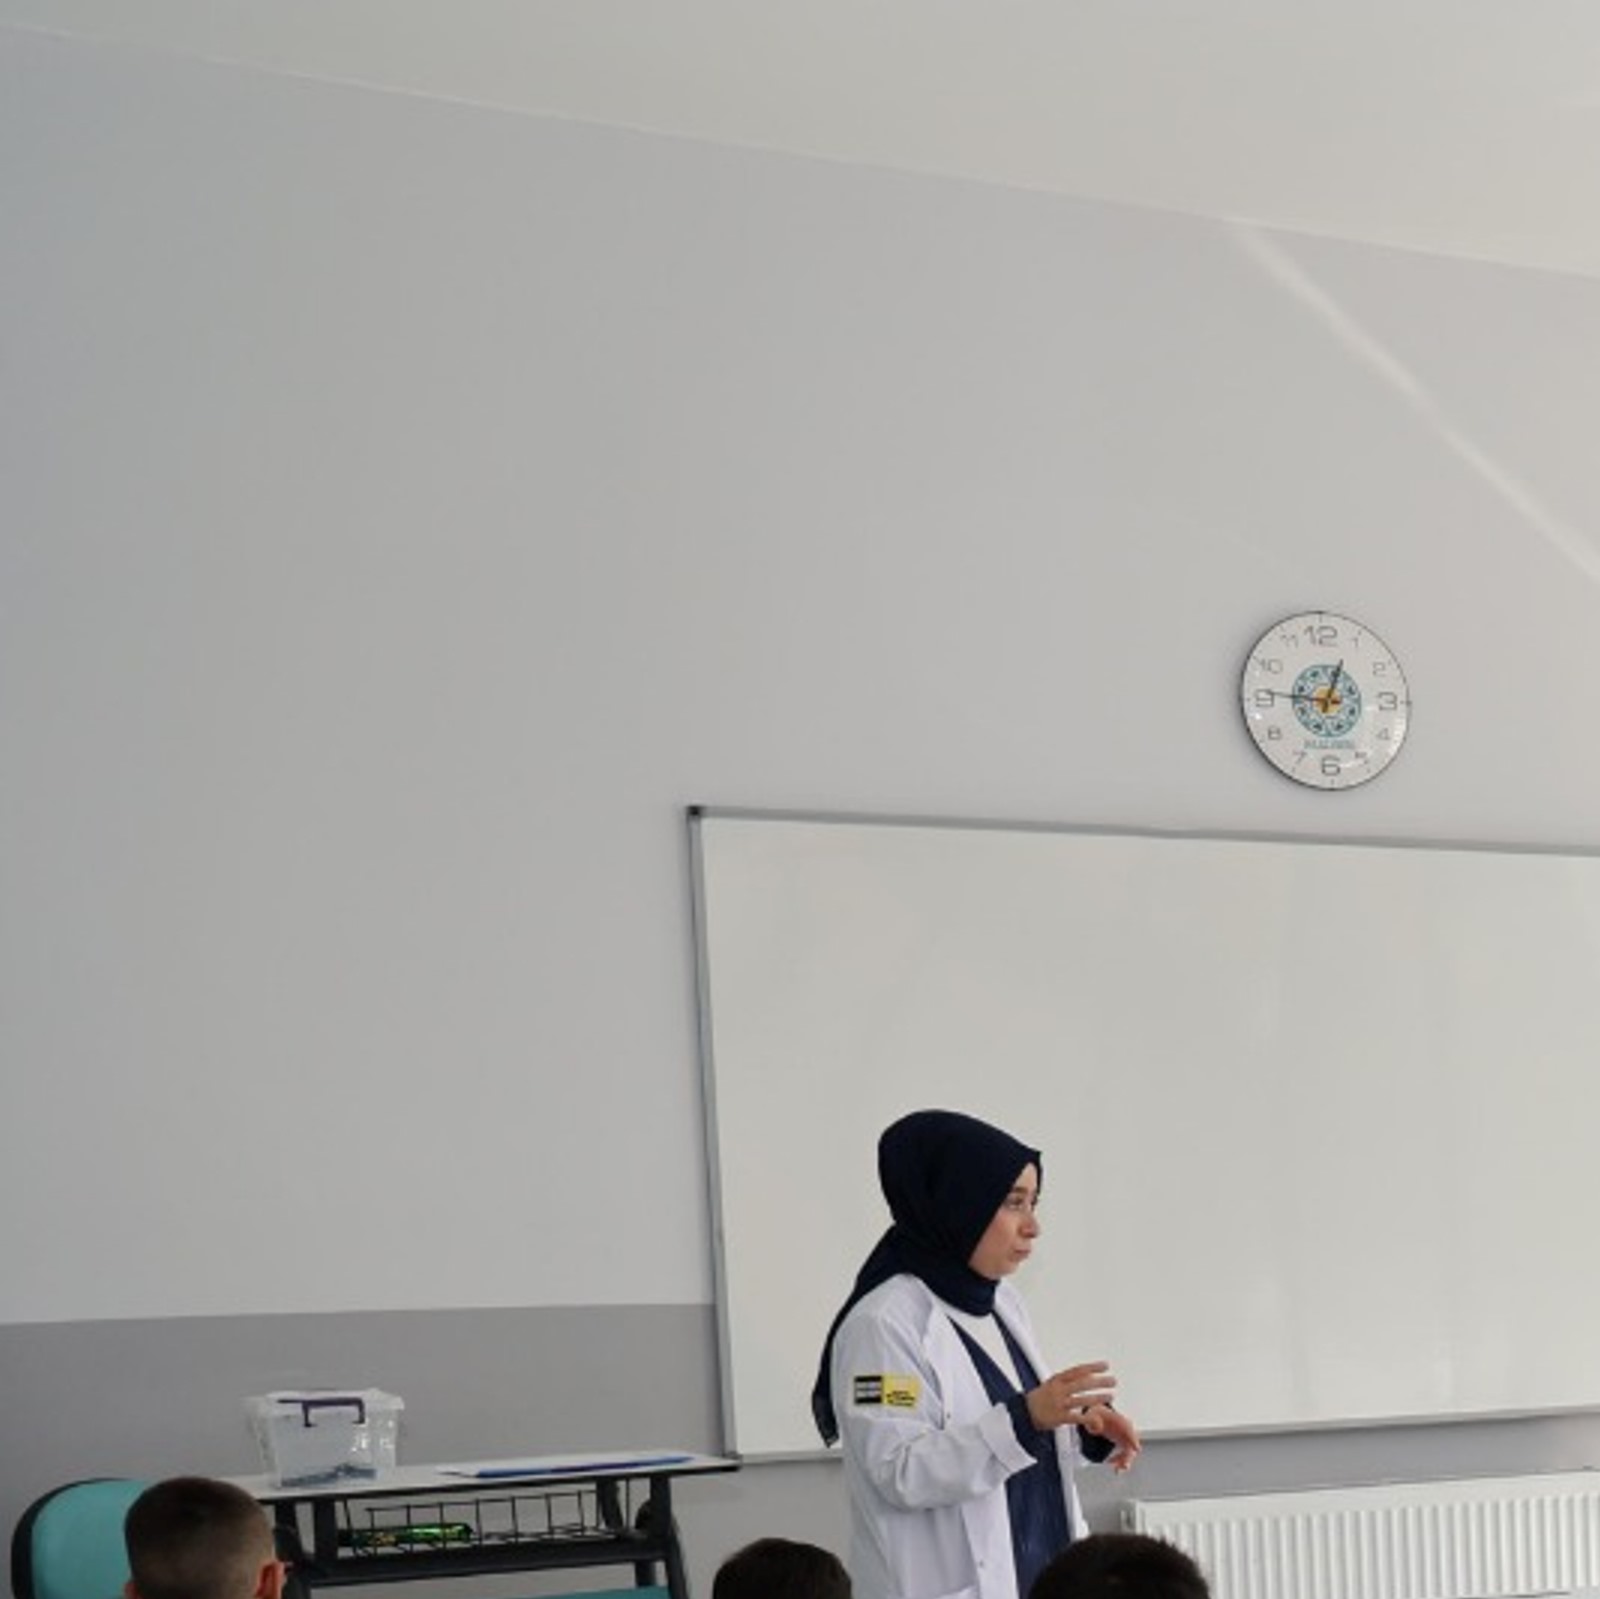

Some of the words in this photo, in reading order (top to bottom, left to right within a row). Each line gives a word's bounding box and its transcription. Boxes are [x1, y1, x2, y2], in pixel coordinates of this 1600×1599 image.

[1304, 625, 1338, 647] 12
[1259, 658, 1283, 675] 10
[1372, 661, 1387, 678] 2
[1255, 688, 1275, 708] 9
[1377, 691, 1398, 711] 3
[1267, 726, 1283, 741] 8
[1376, 727, 1391, 742] 4
[1292, 750, 1308, 765] 7
[1320, 754, 1341, 776] 6
